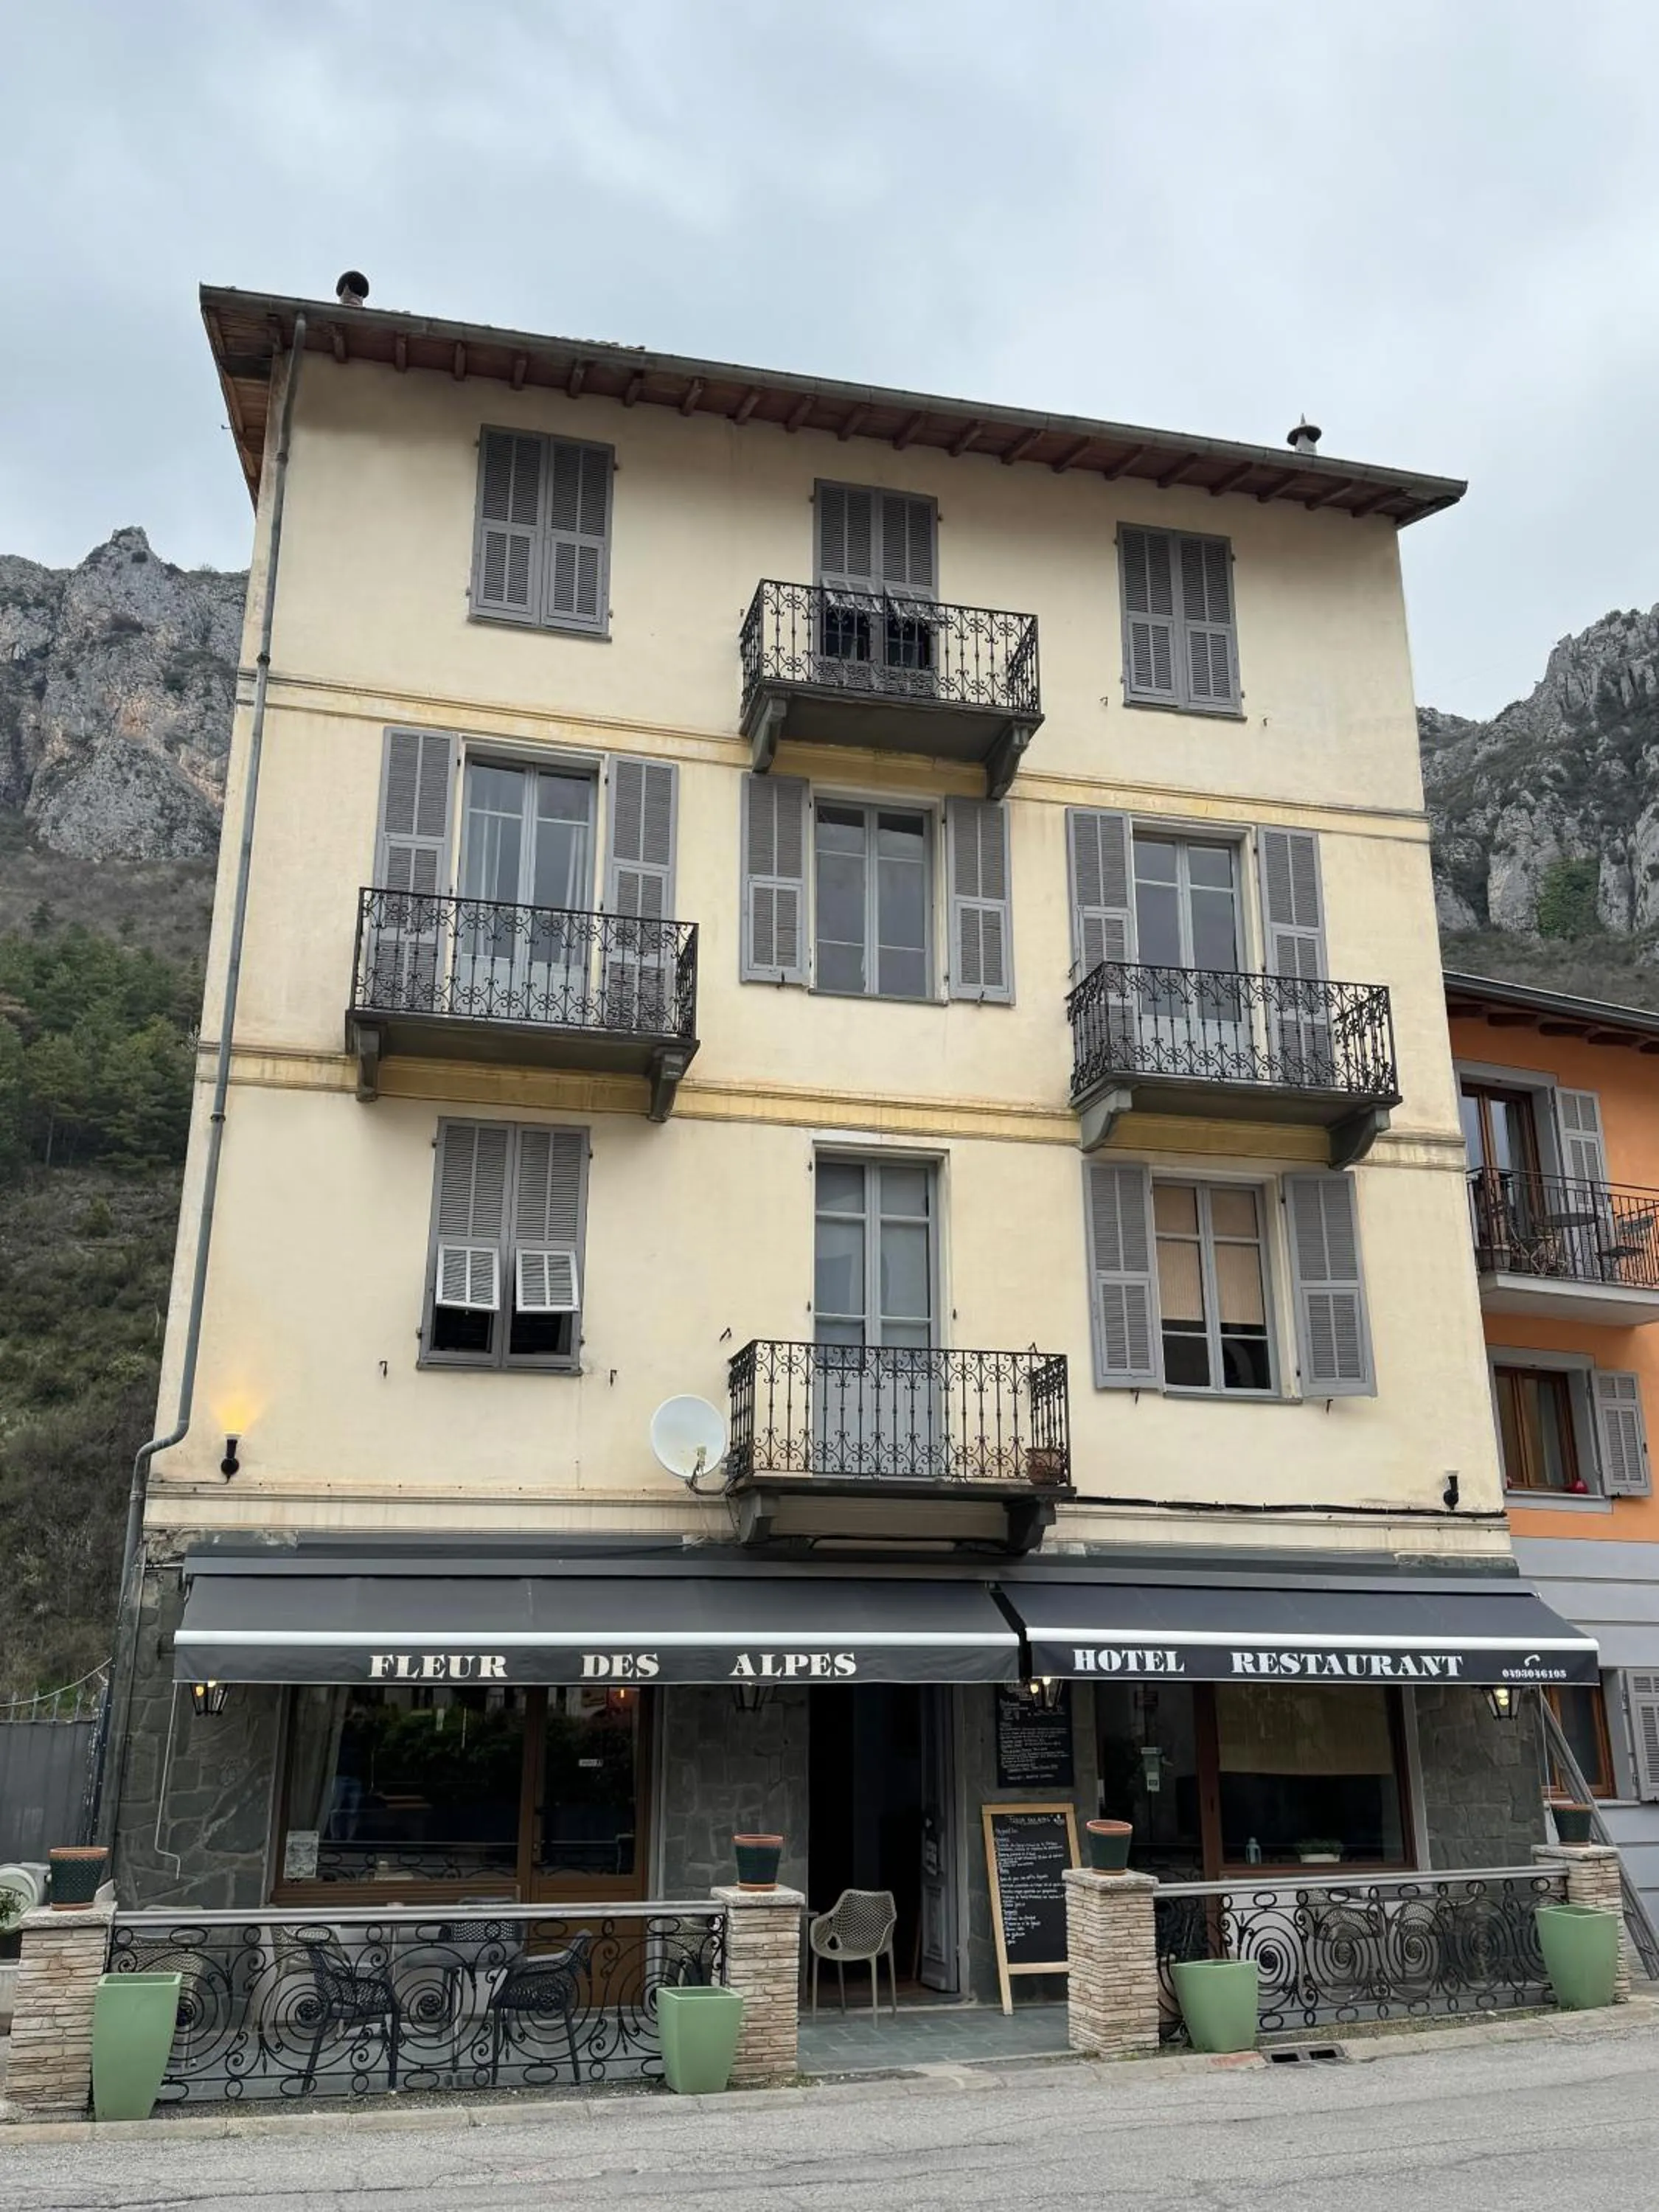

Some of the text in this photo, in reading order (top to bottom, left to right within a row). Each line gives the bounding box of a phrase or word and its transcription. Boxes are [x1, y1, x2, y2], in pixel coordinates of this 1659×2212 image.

[368, 1652, 857, 1679] FLEUR DES ALPES
[1072, 1649, 1464, 1677] HOTEL RESTAURANT
